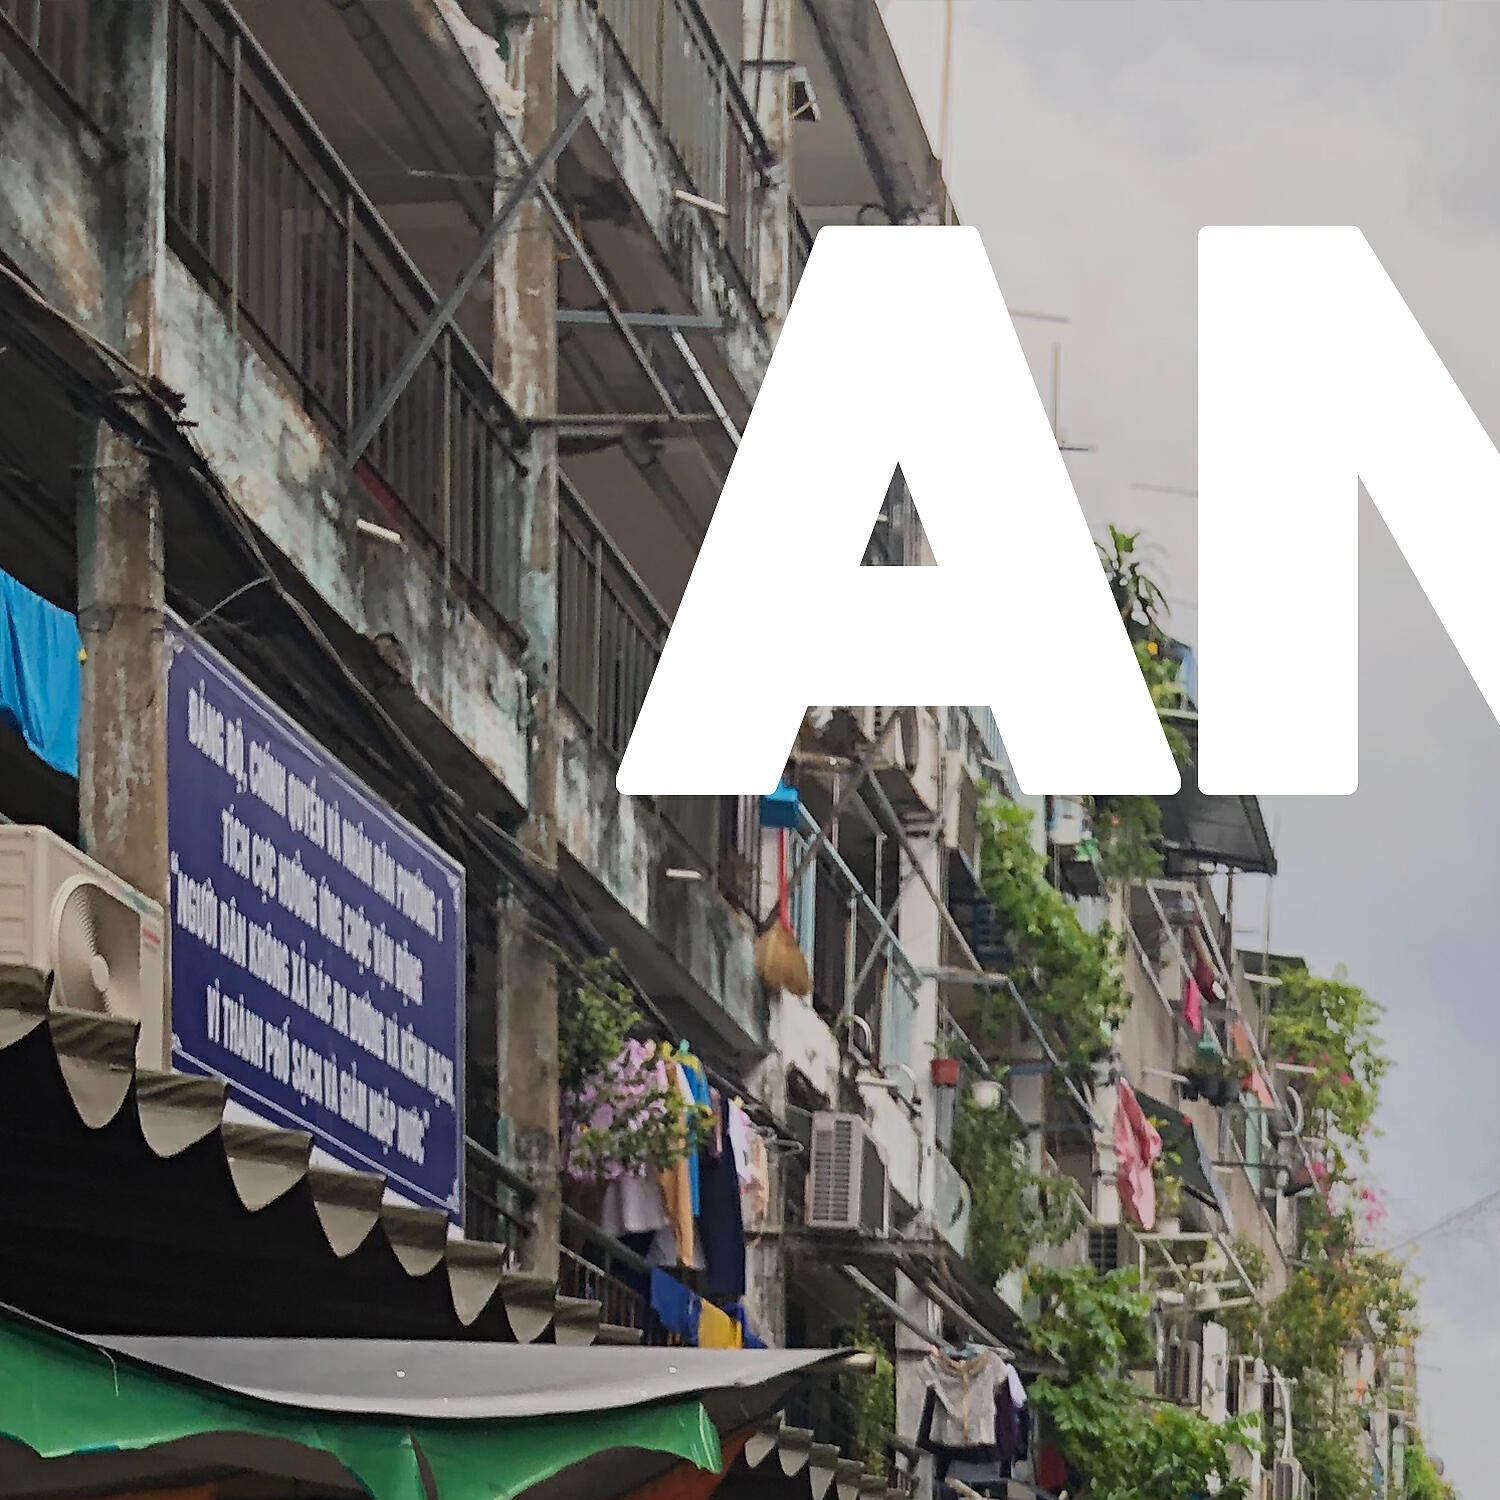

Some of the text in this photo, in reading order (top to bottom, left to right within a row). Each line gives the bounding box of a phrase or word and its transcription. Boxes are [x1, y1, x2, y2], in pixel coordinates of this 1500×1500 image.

[187, 678, 224, 767] ĐẢNG
[248, 740, 286, 817] CHÍNH
[436, 898, 442, 941] 1
[221, 803, 249, 879] TÍCH
[219, 895, 246, 967] DÂN
[248, 921, 289, 996] KHÔNG
[290, 939, 307, 1009] XẢ
[206, 978, 219, 1043] VÌ
[222, 993, 263, 1068] THÀNH
[265, 1015, 289, 1084] PHỐ
[291, 1038, 322, 1105] SẠCH
